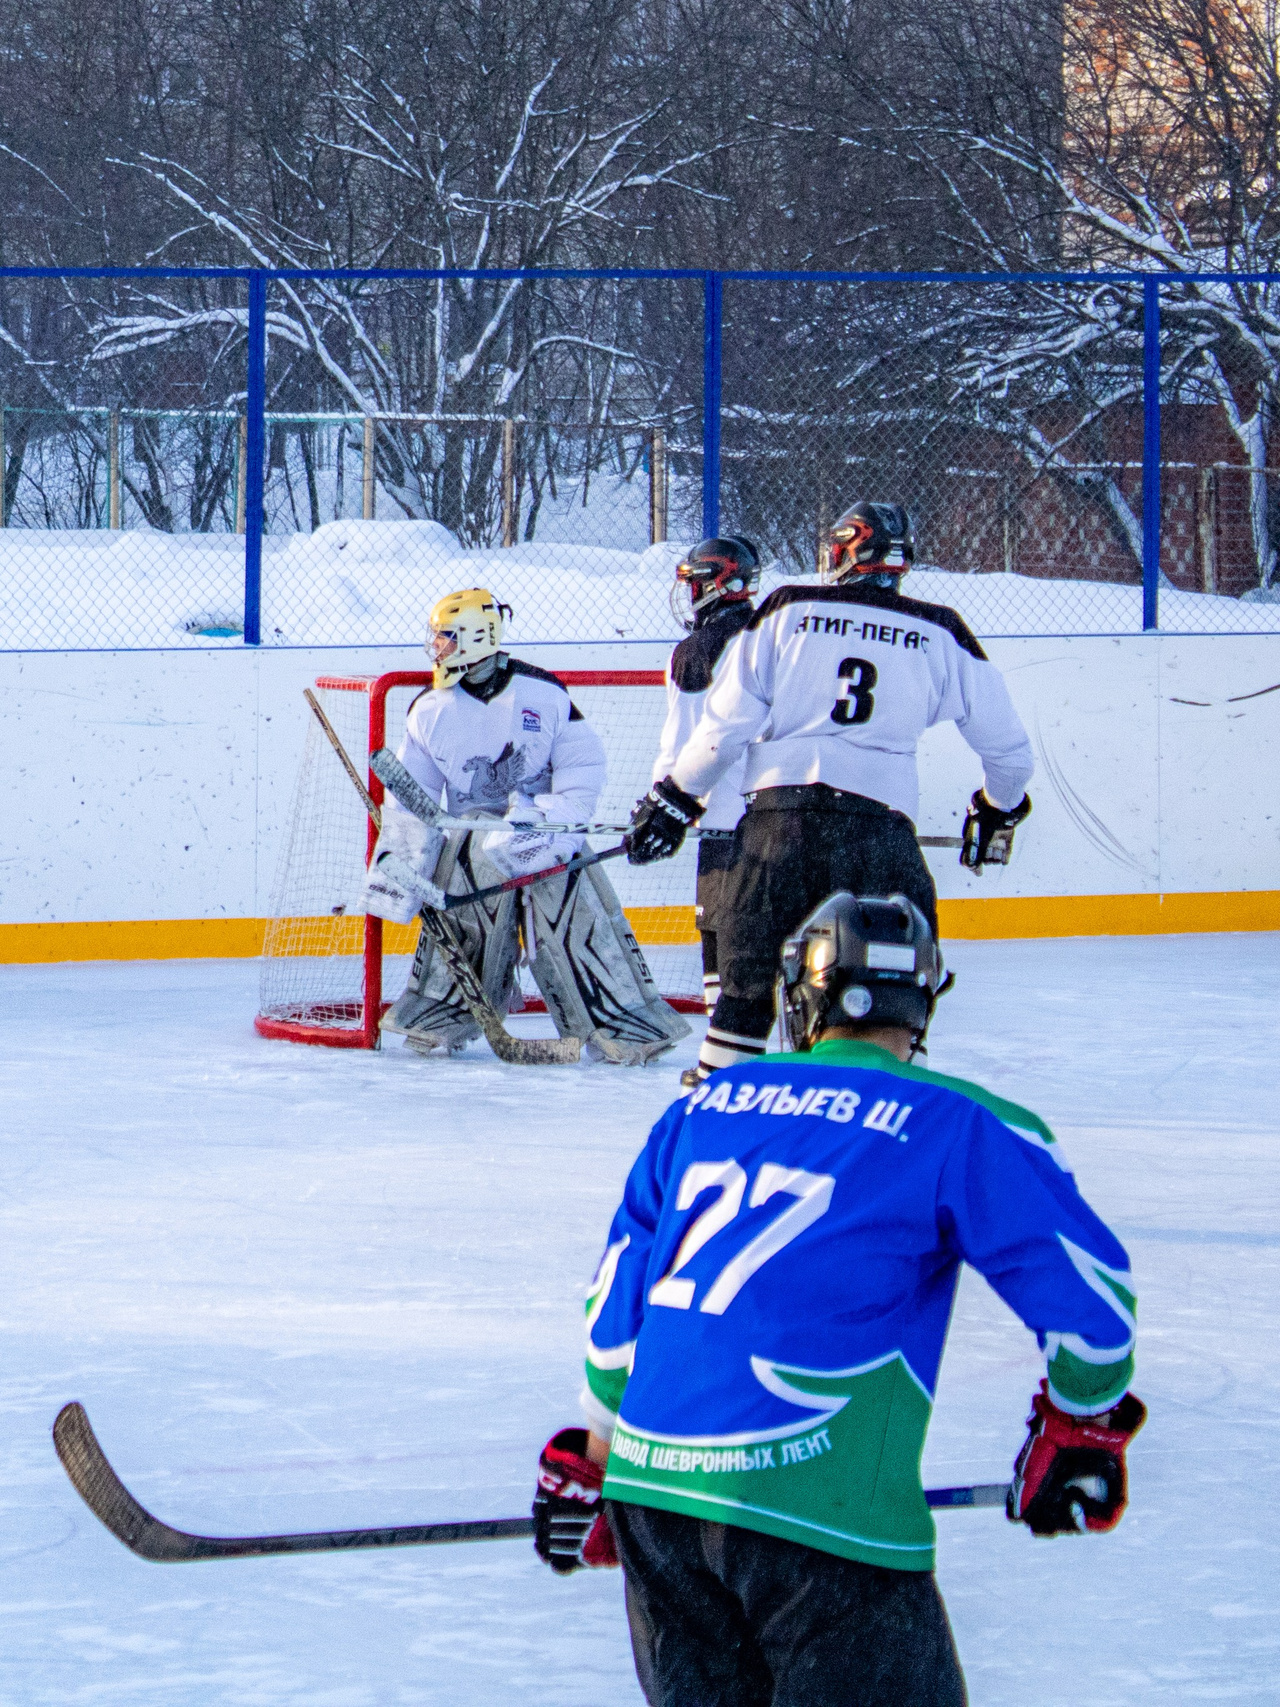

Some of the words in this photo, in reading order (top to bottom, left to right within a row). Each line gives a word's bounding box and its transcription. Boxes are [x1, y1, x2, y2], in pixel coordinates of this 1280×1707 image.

[830, 657, 878, 726] 3
[624, 933, 654, 984] EFSI
[647, 1157, 837, 1317] 27
[651, 1447, 776, 1473] ШЕВРОННЫХ
[781, 1428, 833, 1466] ЛЕНТ
